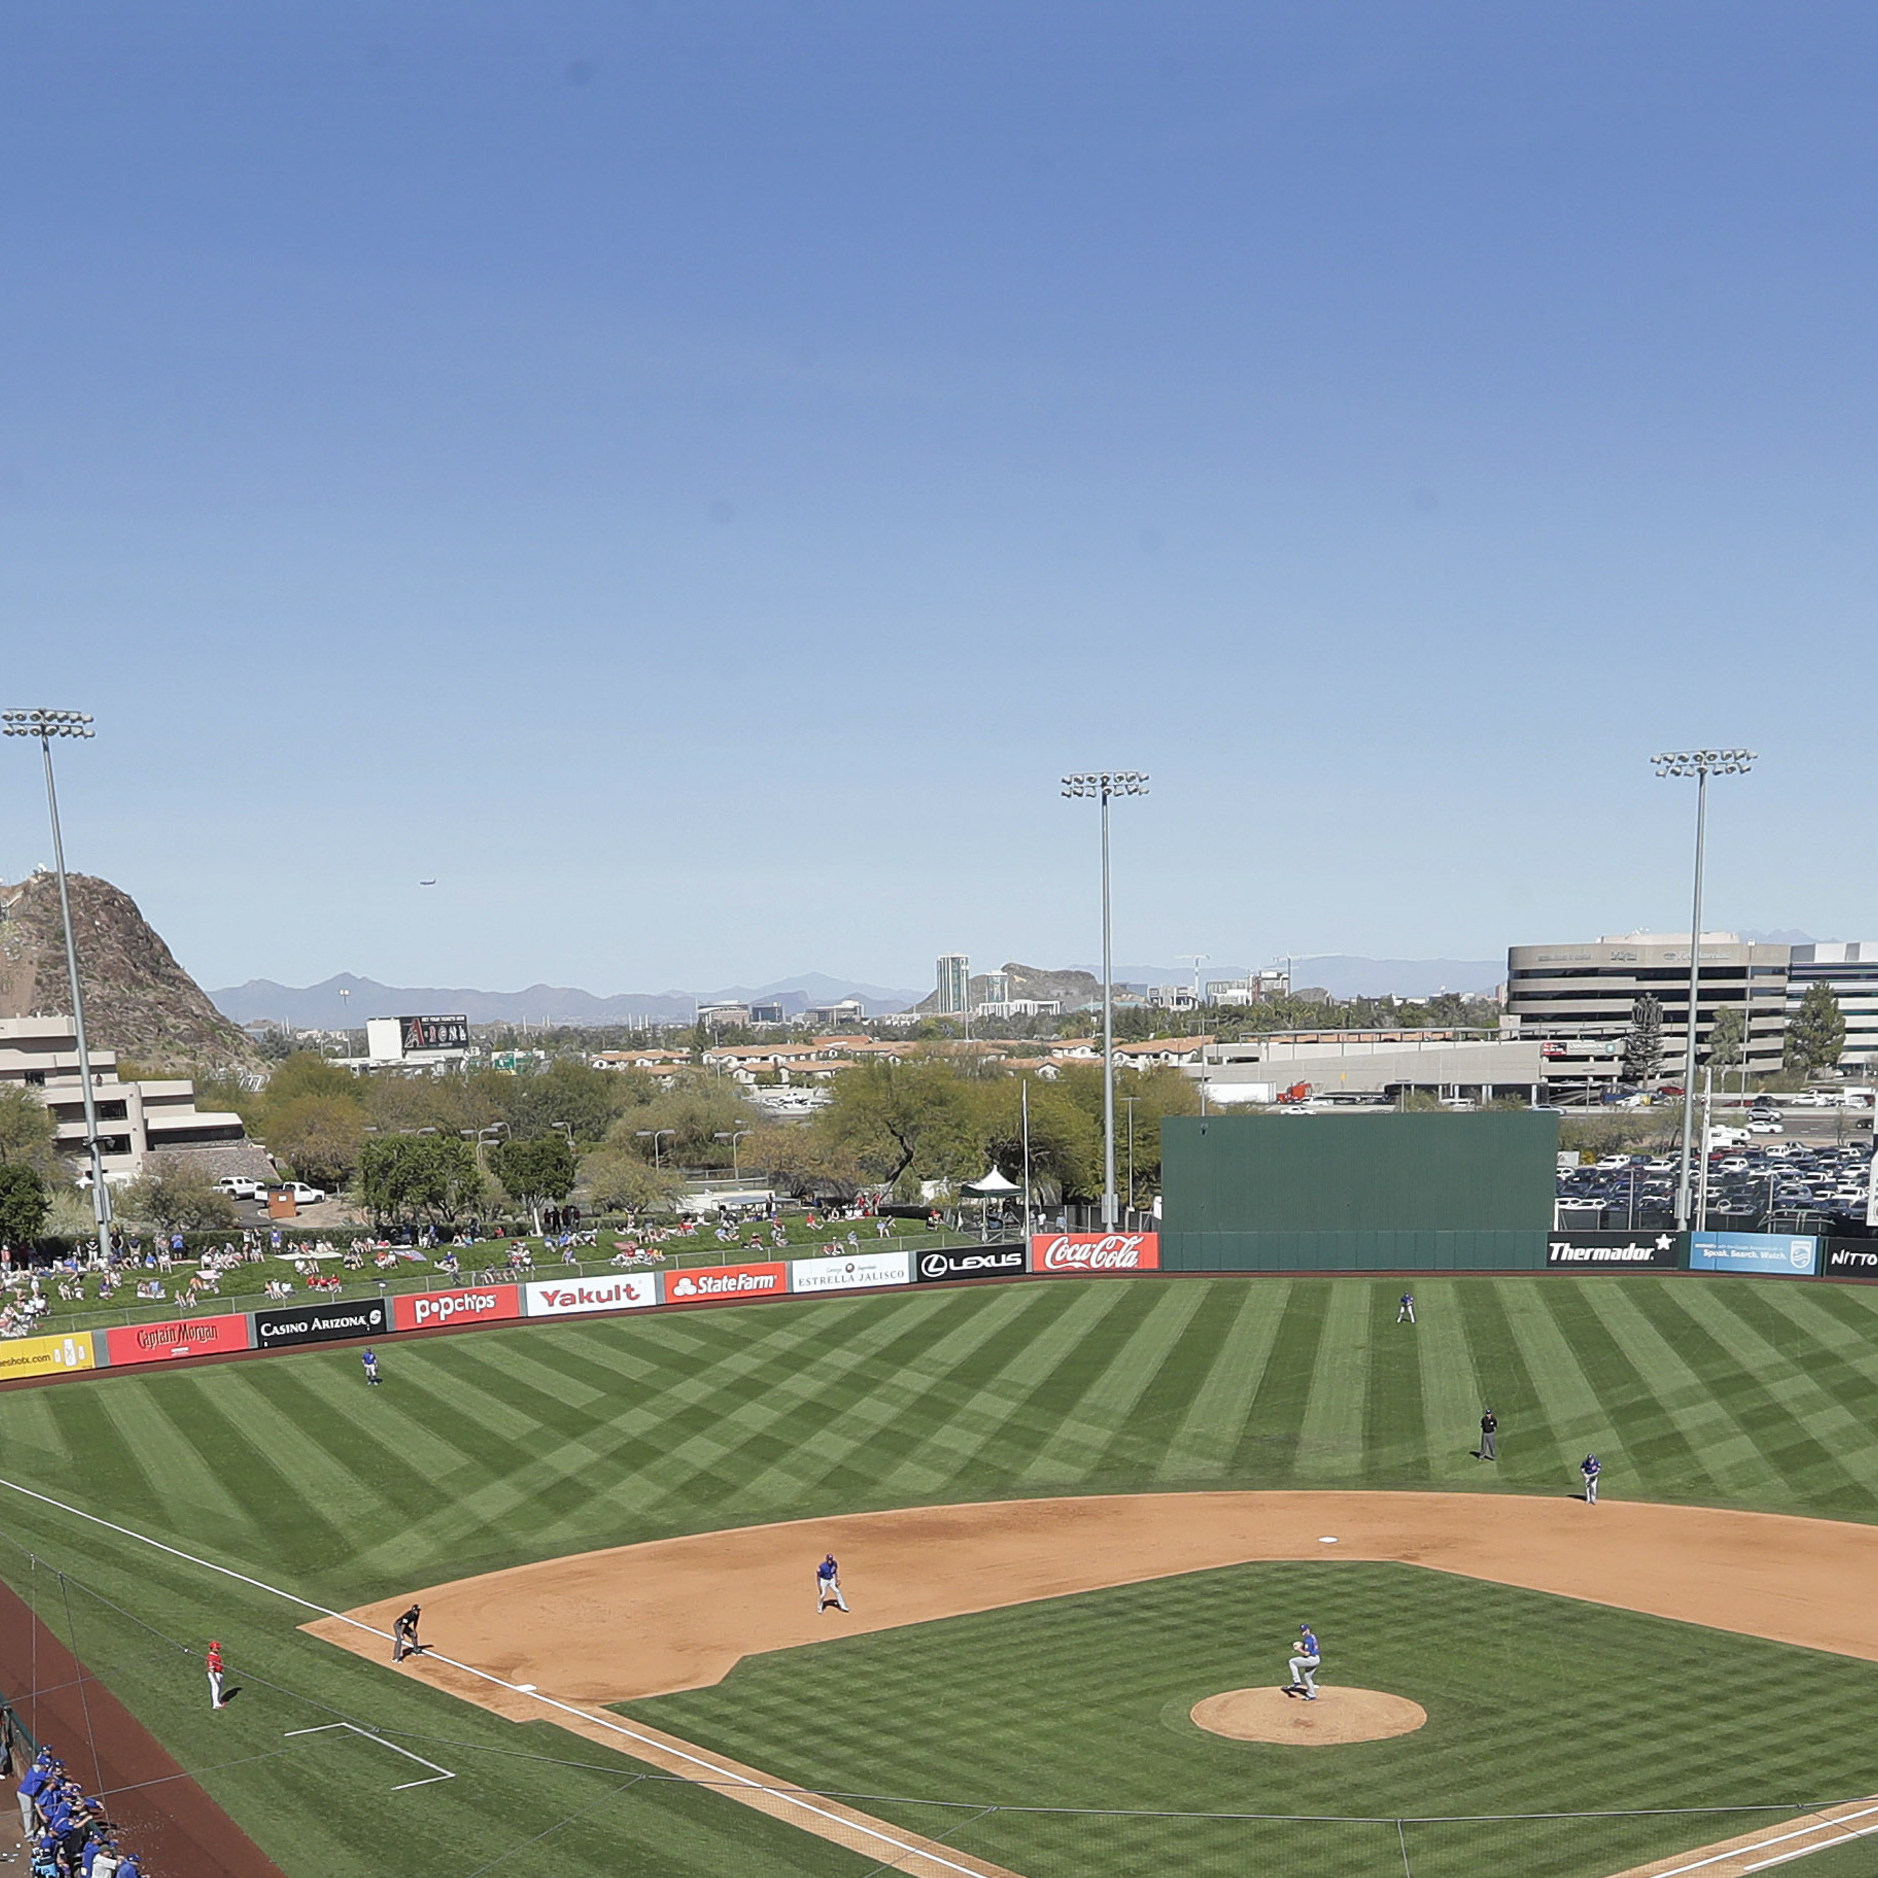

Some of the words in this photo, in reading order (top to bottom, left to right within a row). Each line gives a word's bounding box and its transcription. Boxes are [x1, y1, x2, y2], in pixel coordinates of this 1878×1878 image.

[949, 1252, 1021, 1271] LEXUS
[1044, 1235, 1145, 1270] Coca-Cola
[1831, 1249, 1877, 1266] NITTO
[798, 1272, 855, 1287] ESTRELLA
[858, 1269, 905, 1282] JALISCO
[540, 1284, 640, 1307] Yakult
[414, 1292, 496, 1324] popchips
[137, 1327, 176, 1350] Captain
[174, 1323, 218, 1342] Morgan
[260, 1321, 308, 1338] CASINO
[311, 1314, 366, 1332] ARIZONA
